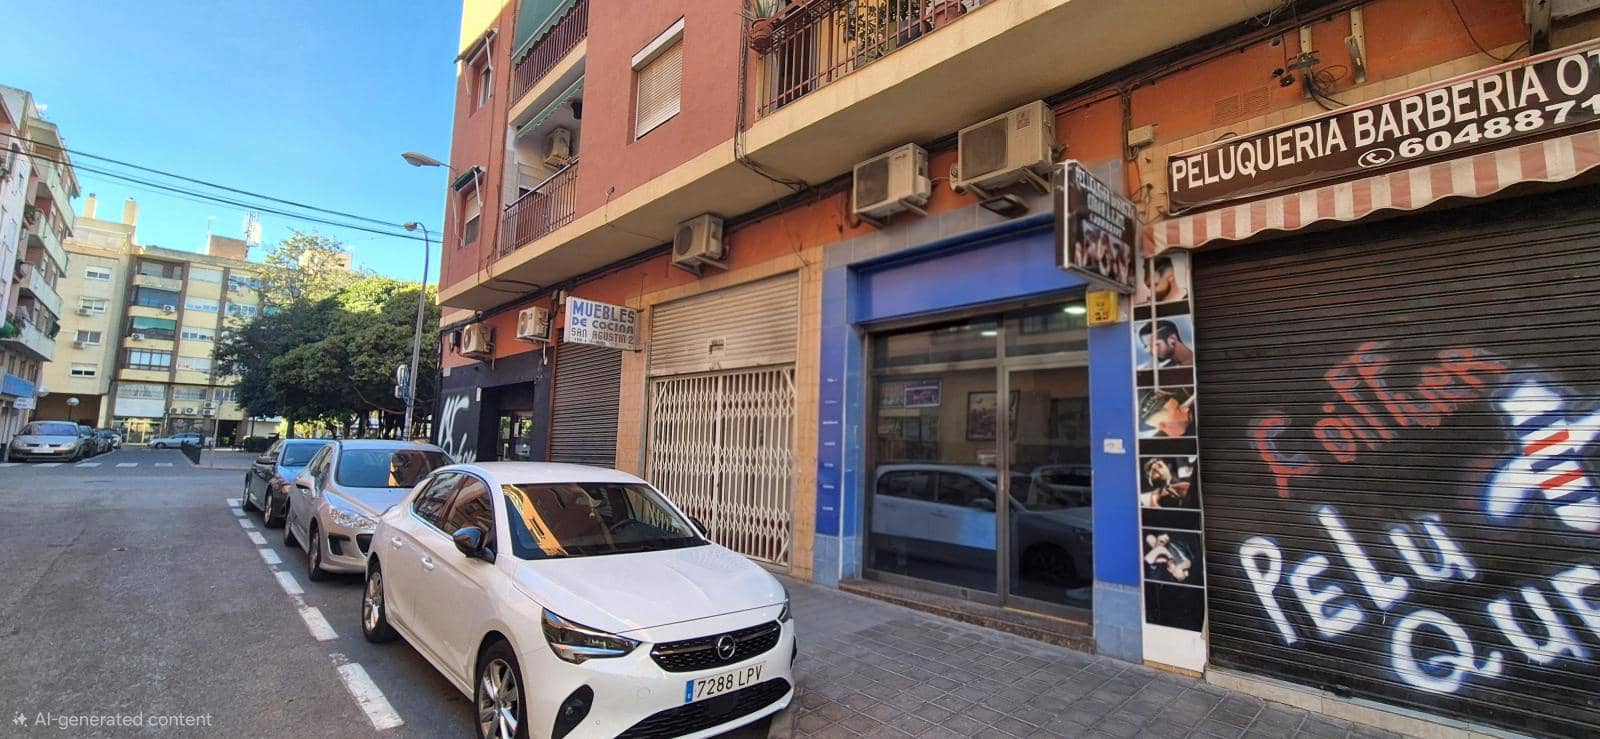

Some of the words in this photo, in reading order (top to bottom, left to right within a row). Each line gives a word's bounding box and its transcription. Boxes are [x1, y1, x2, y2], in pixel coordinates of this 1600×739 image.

[1171, 118, 1346, 193] PELUQUERIA
[1353, 65, 1549, 148] BARBERIA
[572, 301, 635, 324] MUEBLES
[571, 316, 588, 327] DE
[592, 320, 634, 335] COCINA
[571, 327, 588, 338] SAN
[592, 330, 626, 344] AGUSTIN
[696, 673, 734, 699] 7288
[738, 665, 763, 687] LPV
